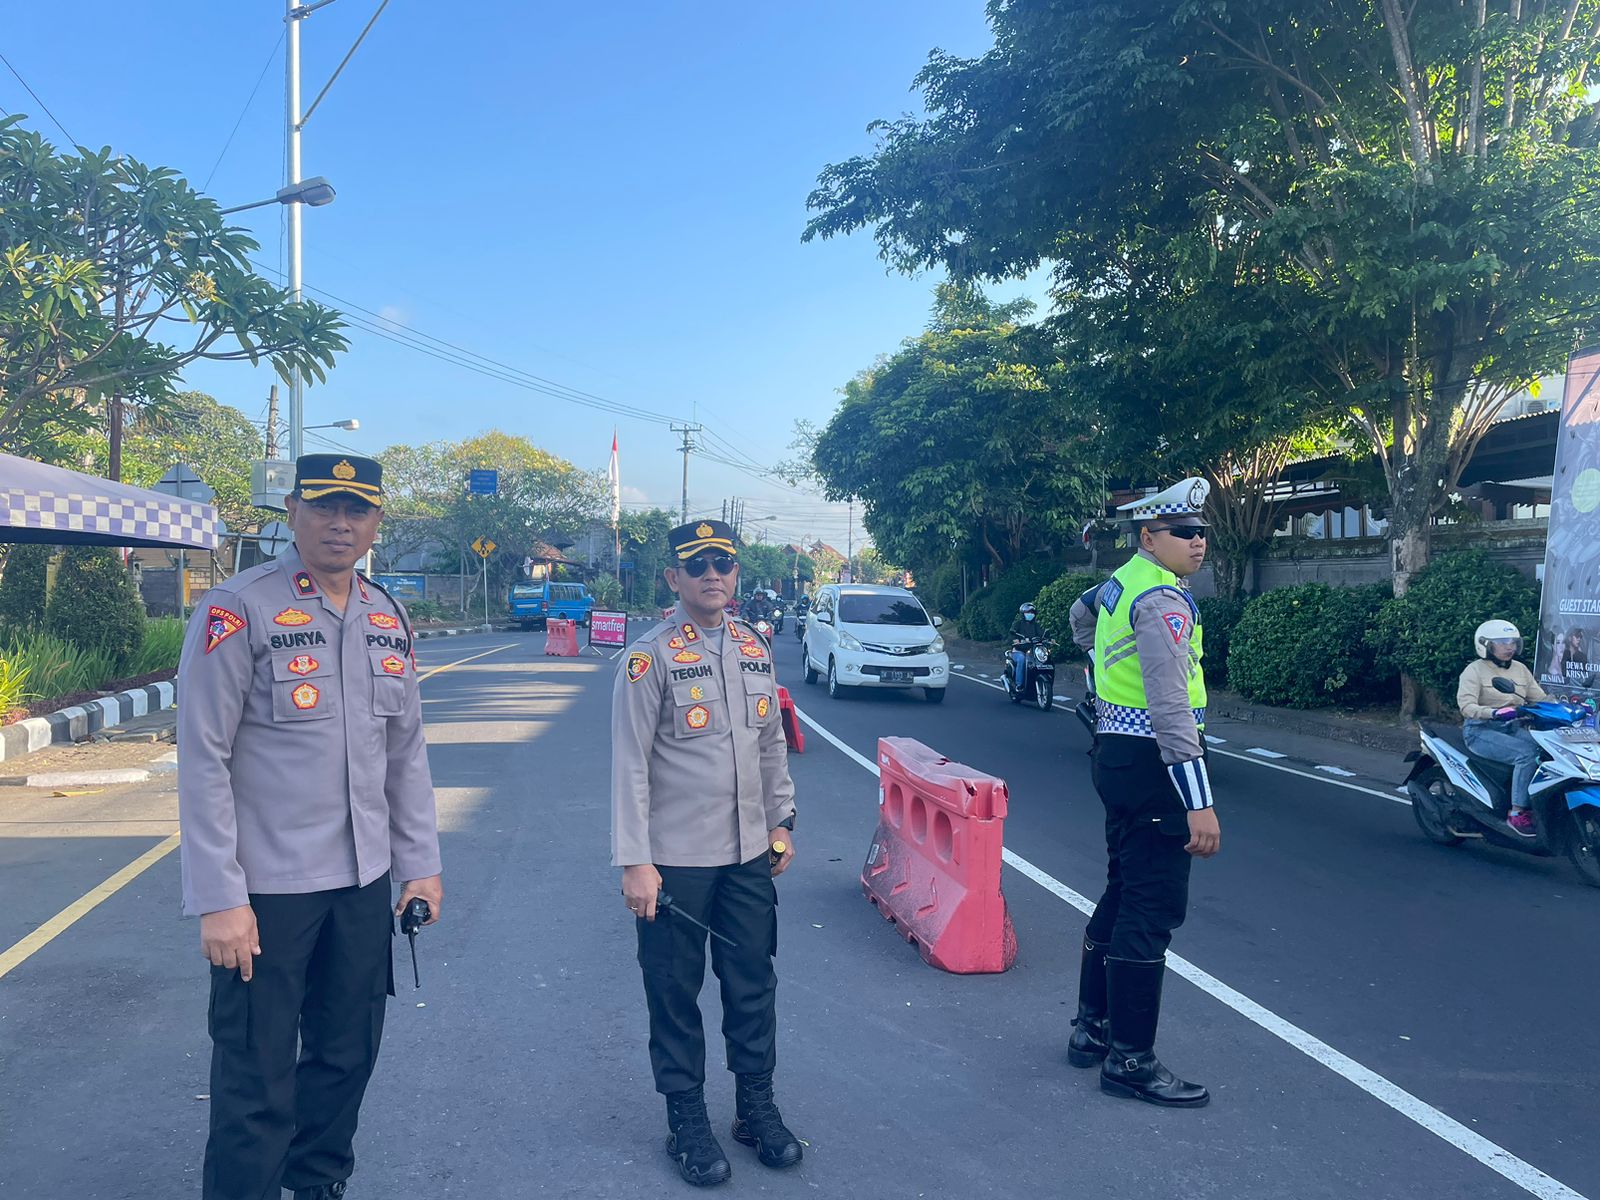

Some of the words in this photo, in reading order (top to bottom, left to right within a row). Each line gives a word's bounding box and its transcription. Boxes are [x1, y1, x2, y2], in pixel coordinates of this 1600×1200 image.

[1560, 599, 1582, 612] GUEST
[211, 608, 225, 616] OPS
[224, 612, 243, 627] POLRI
[591, 619, 625, 633] smartfren
[270, 631, 327, 649] SURYA
[366, 634, 407, 652] POLRI
[670, 665, 713, 681] TEGUH
[1566, 661, 1584, 671] DEWA
[1566, 670, 1589, 679] KRISNA
